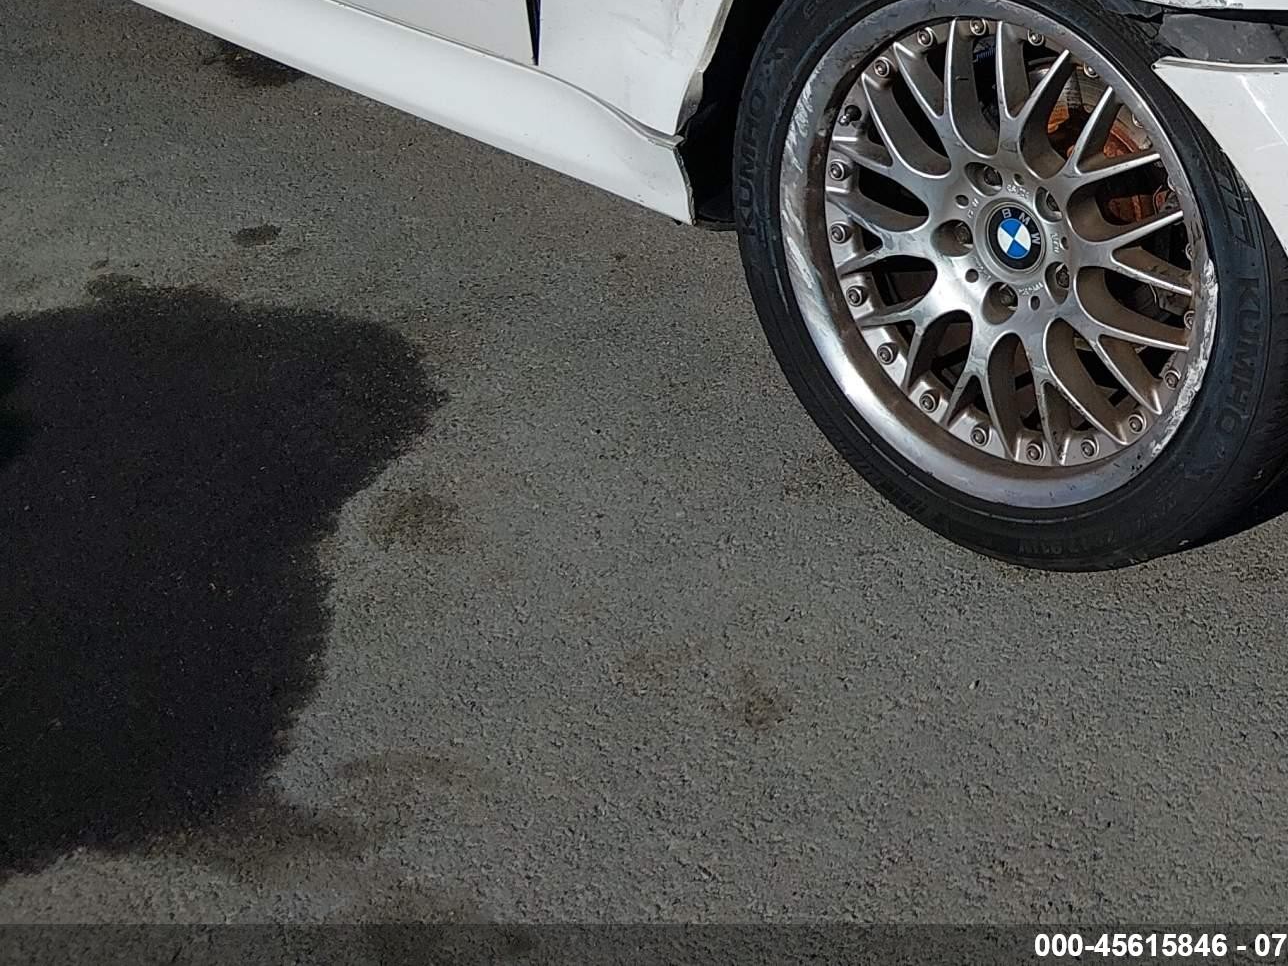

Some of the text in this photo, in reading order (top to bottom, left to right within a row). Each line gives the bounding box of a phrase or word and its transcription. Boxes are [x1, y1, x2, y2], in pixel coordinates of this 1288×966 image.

[738, 88, 767, 236] KUMHO
[1002, 208, 1041, 245] BMW
[1216, 277, 1261, 434] KUMHO
